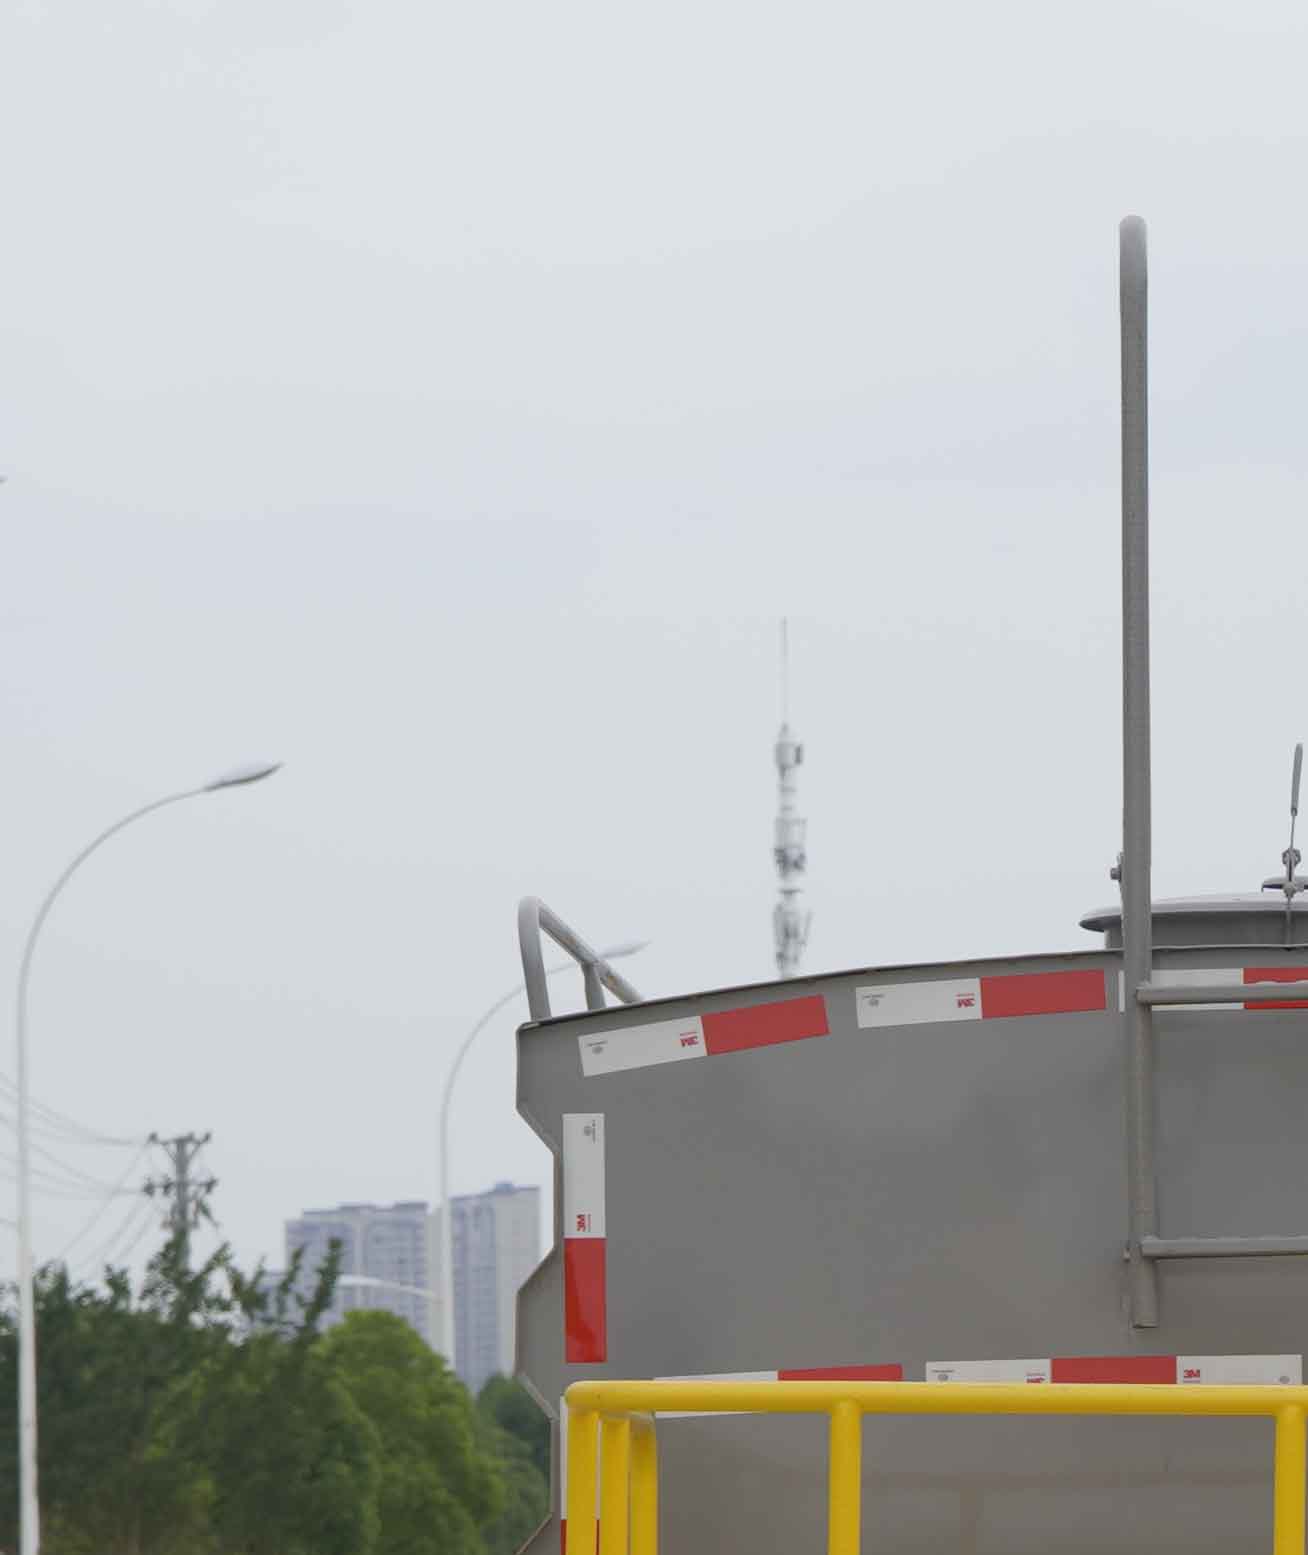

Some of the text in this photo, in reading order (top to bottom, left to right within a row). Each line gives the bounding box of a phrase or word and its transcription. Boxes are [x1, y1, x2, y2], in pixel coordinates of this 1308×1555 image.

[956, 998, 976, 1008] 3M
[680, 1035, 699, 1048] 3M
[1183, 1369, 1201, 1379] 3M
